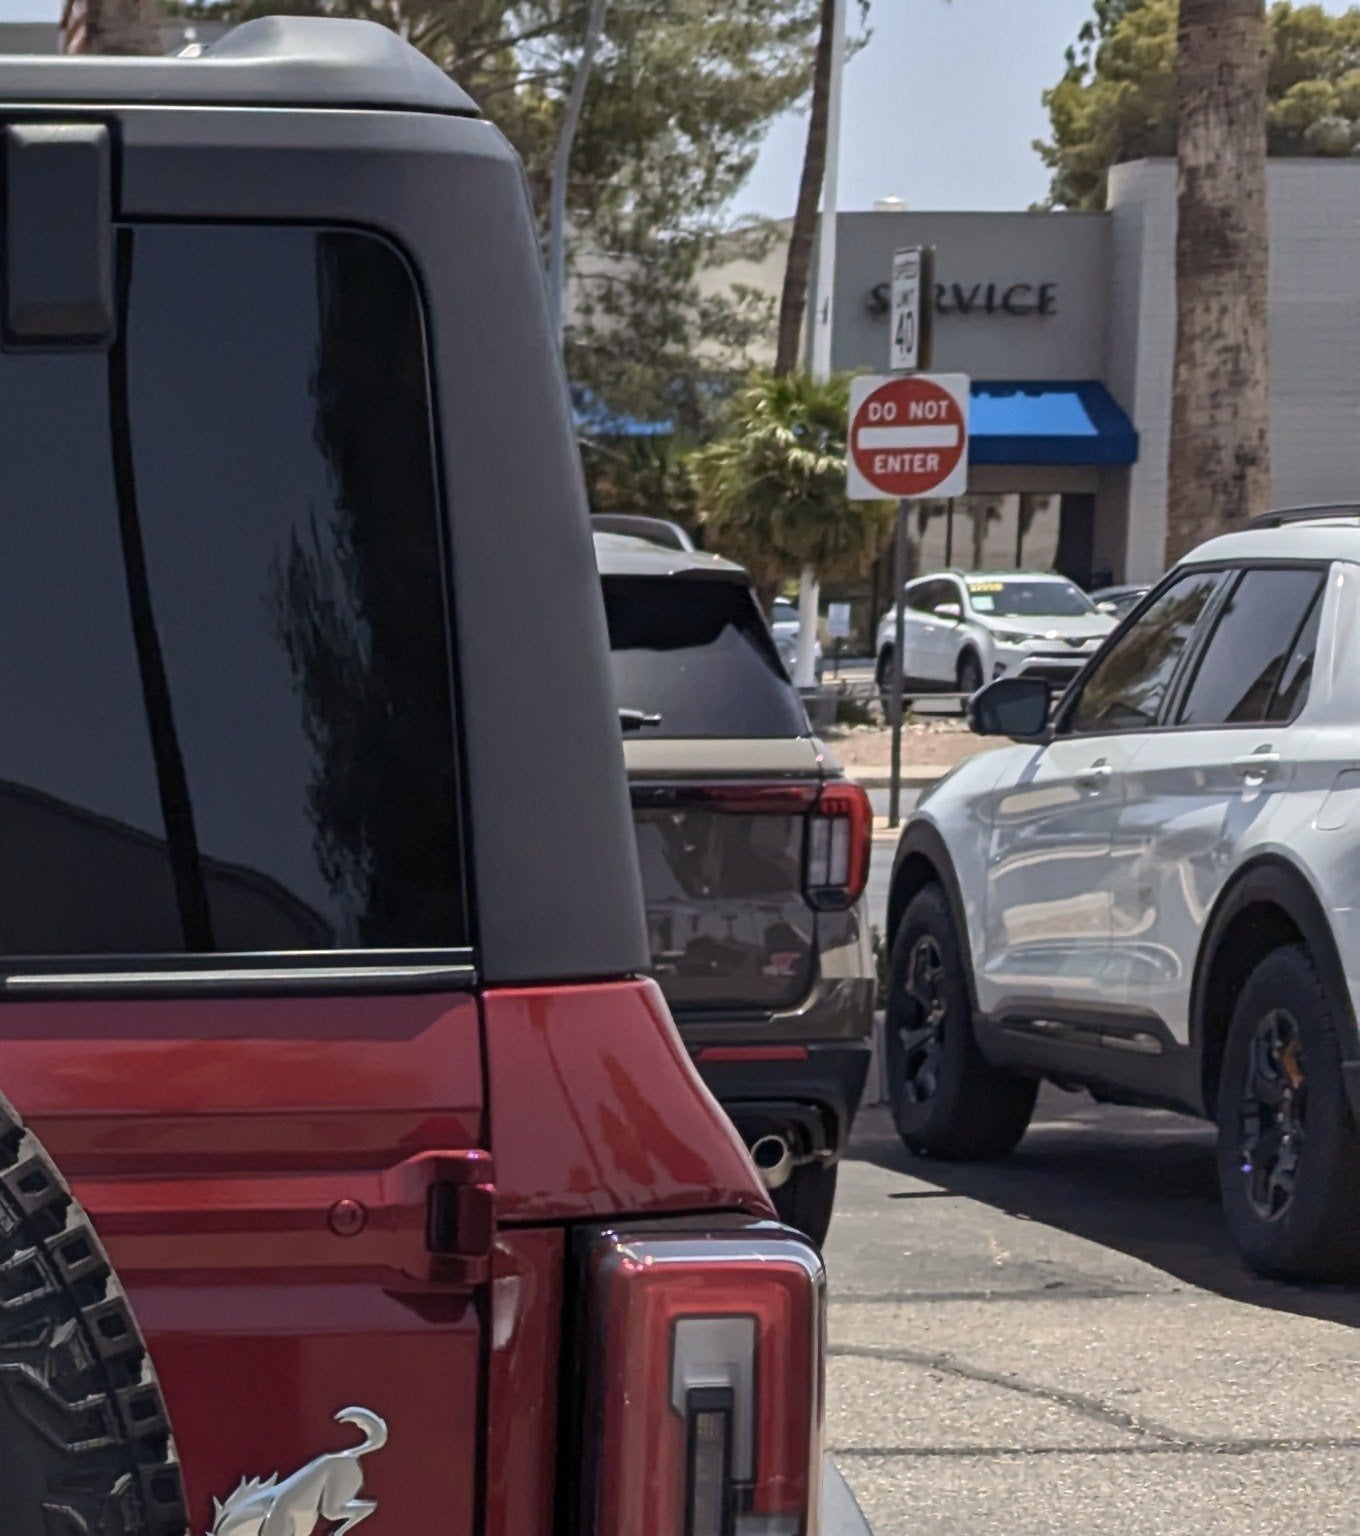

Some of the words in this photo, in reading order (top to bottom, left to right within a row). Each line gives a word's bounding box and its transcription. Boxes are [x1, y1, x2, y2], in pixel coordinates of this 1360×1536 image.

[865, 281, 1059, 316] SRVICE
[867, 401, 898, 422] DO
[908, 400, 949, 420] NOT
[873, 453, 940, 475] ENTER
